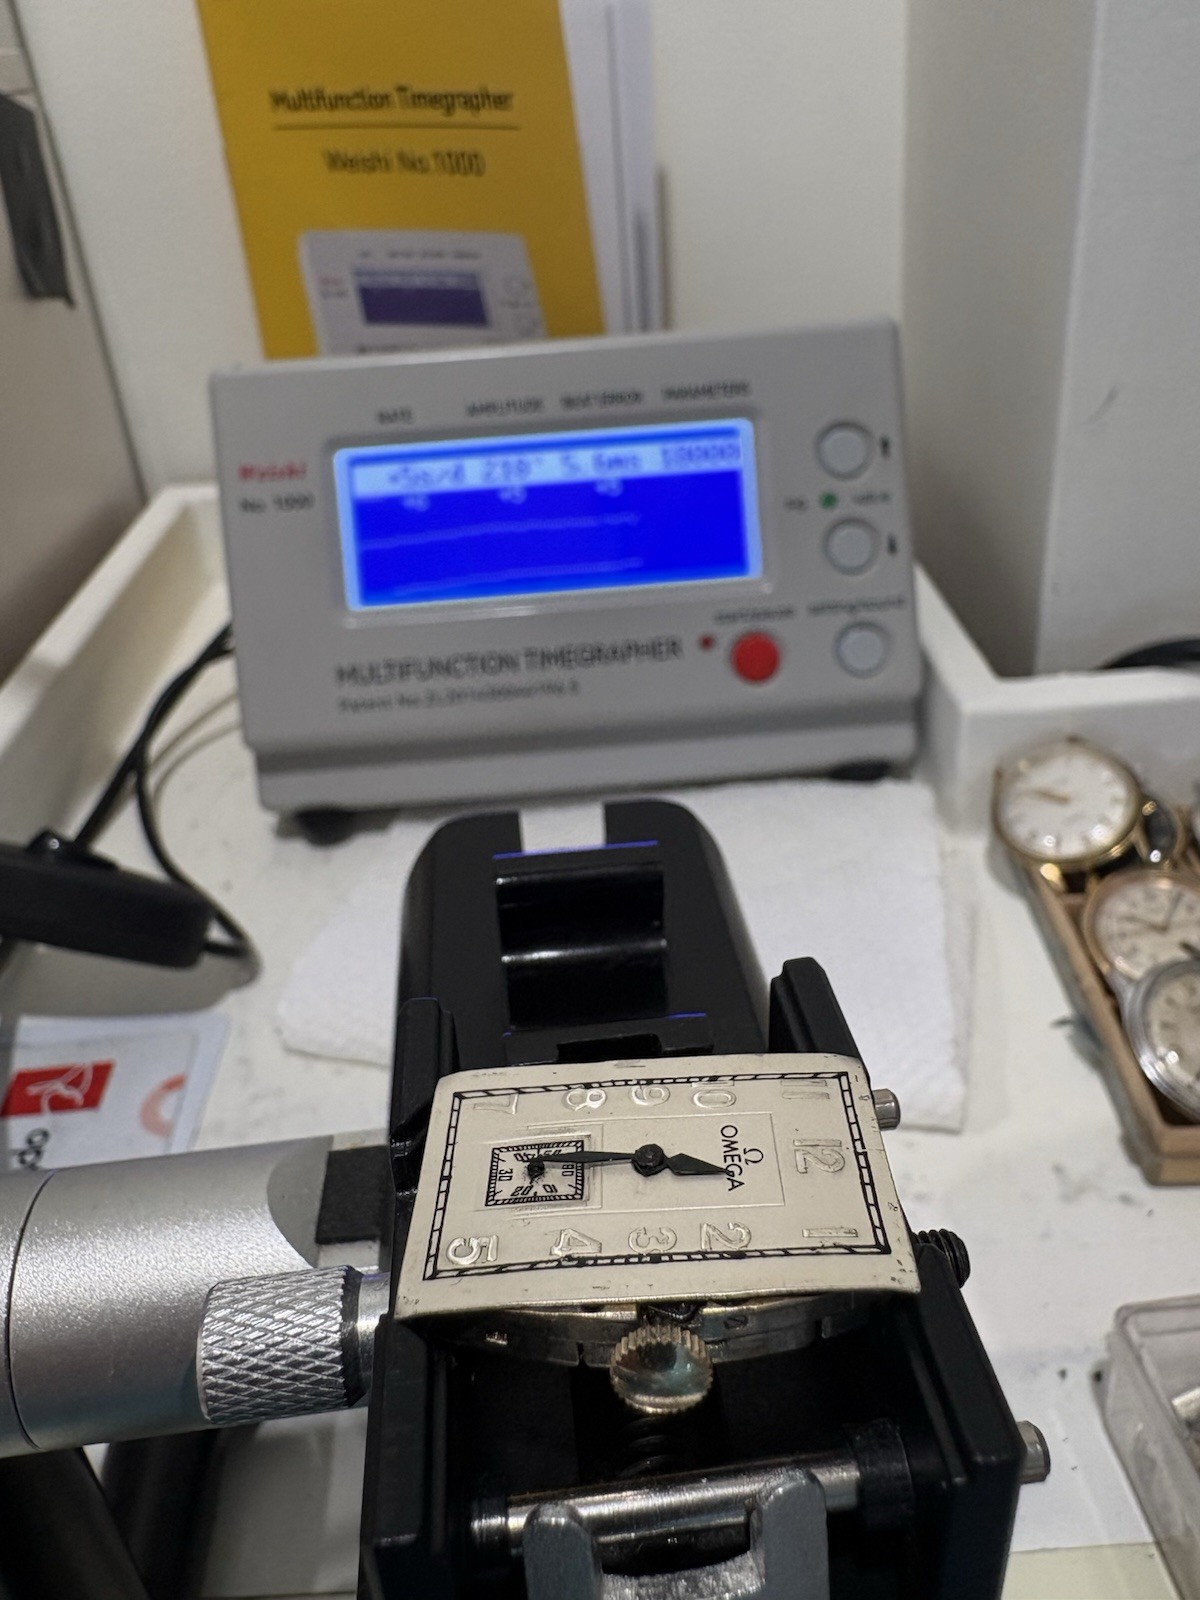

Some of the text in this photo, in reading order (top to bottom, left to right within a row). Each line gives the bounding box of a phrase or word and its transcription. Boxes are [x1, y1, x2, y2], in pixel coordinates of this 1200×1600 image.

[270, 85, 513, 117] Multifunction Timegrapher
[562, 1087, 607, 1112] 8
[720, 1124, 745, 1192] OMEGA
[792, 1138, 846, 1174] 12
[499, 1168, 513, 1182] 30
[510, 1184, 534, 1197] 20
[550, 1227, 602, 1257] 4
[628, 1226, 677, 1255] 3
[701, 1222, 752, 1251] 2
[802, 1228, 859, 1239] 1
[446, 1234, 499, 1266] 5
